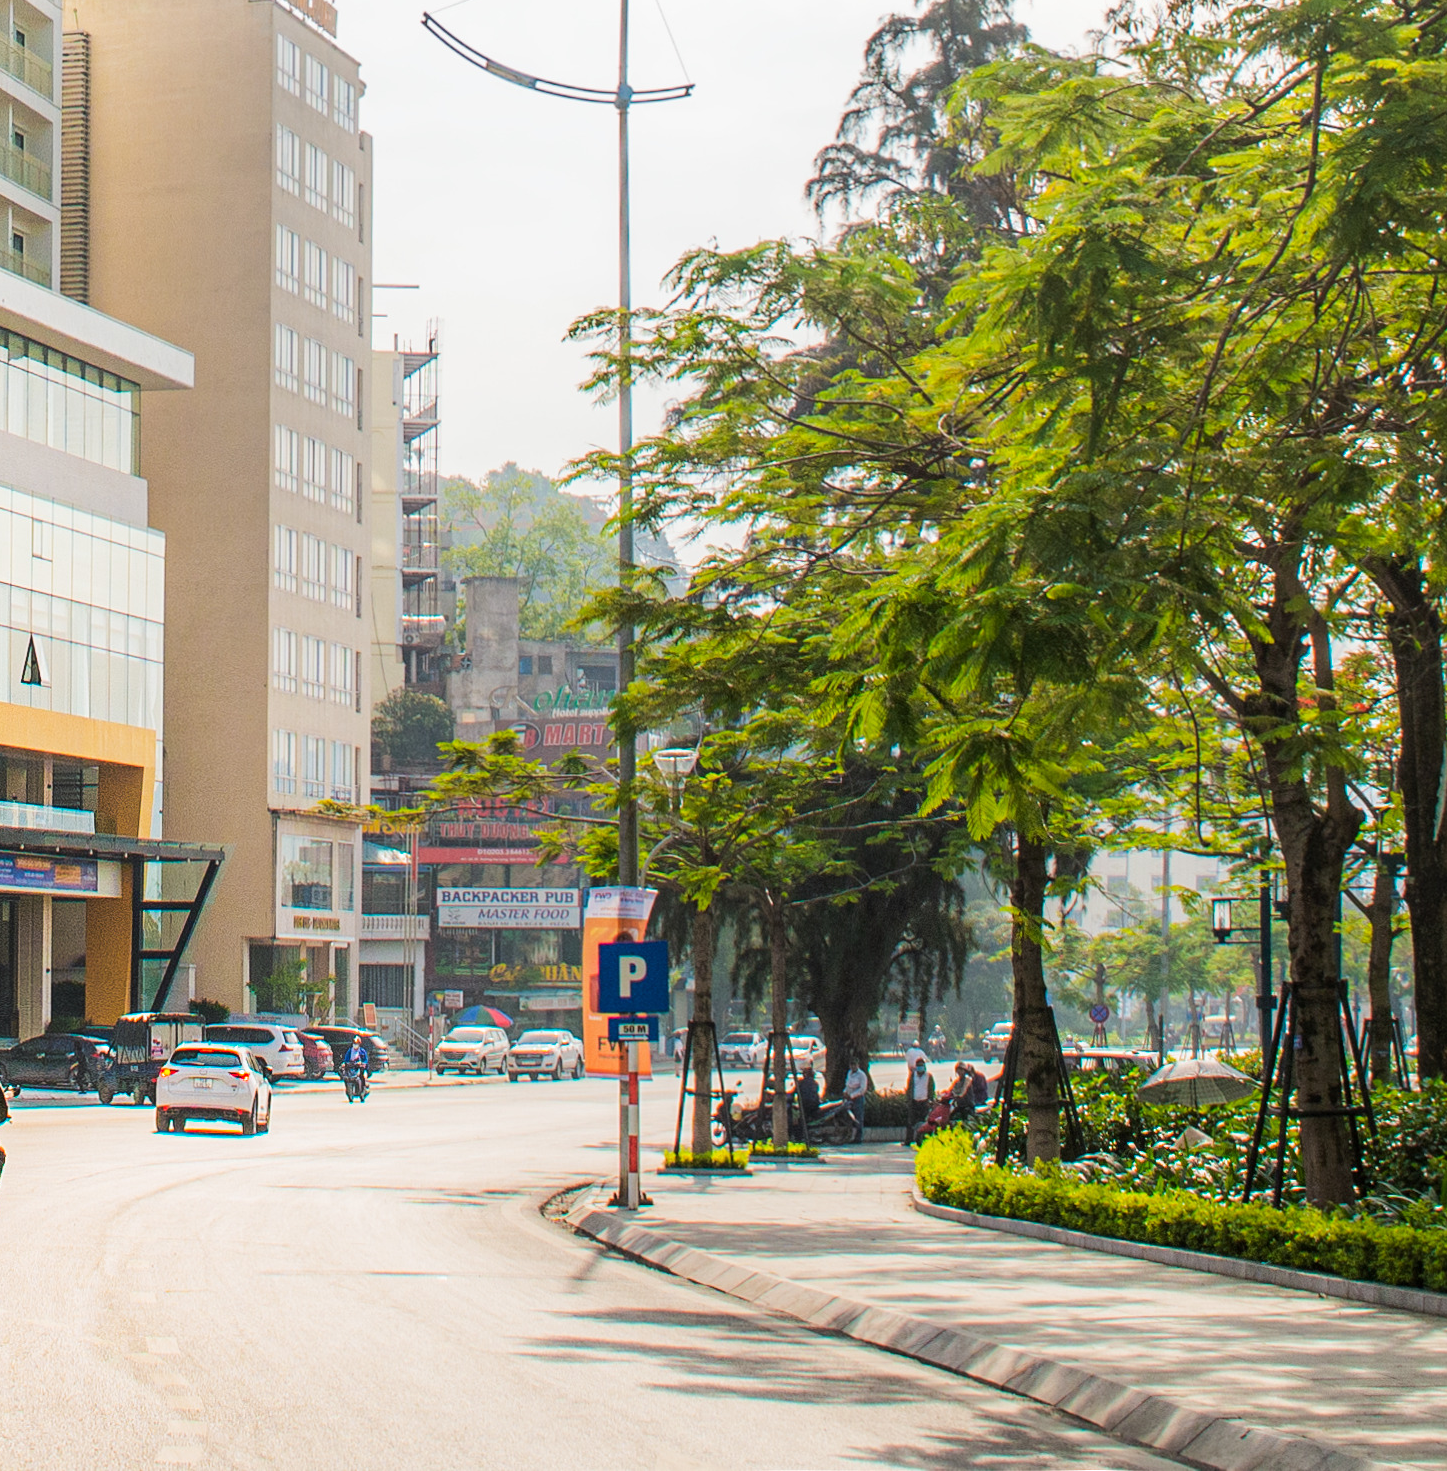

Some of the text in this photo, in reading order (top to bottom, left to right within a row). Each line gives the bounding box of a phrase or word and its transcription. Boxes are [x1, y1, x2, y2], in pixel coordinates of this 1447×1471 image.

[543, 722, 606, 746] MART
[441, 890, 574, 903] BACKPACKER PUB
[478, 908, 570, 919] MASTER FOOD
[619, 955, 647, 998] P
[623, 1024, 646, 1034] 50 M
